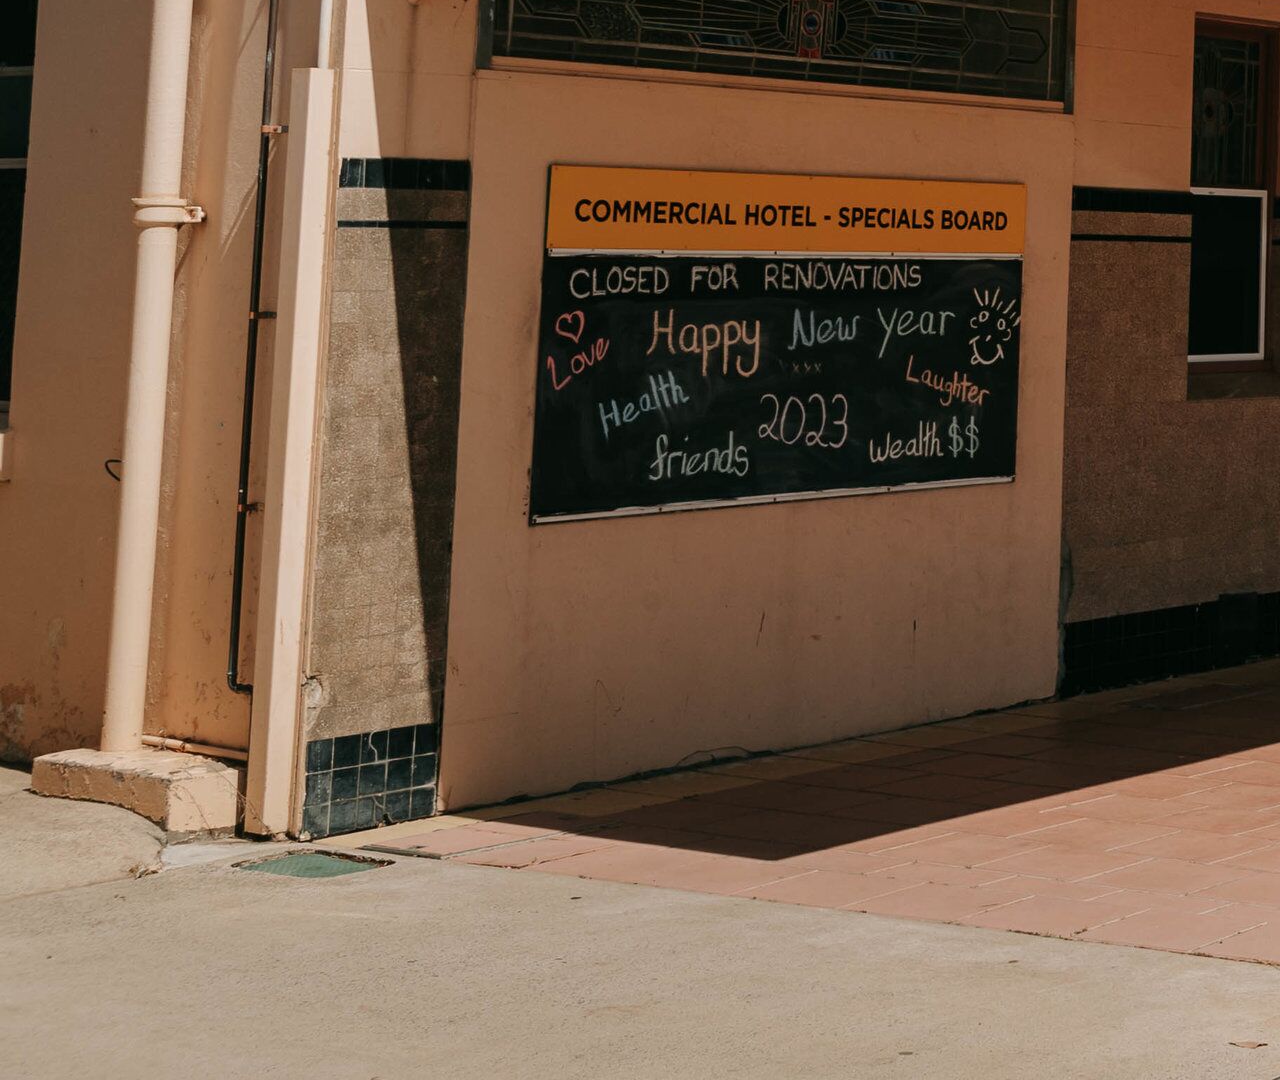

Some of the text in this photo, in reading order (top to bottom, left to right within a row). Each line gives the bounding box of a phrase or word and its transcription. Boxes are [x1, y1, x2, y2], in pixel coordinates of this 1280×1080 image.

[574, 198, 737, 226] COMMERCIAL
[744, 204, 817, 228] HOTEL
[838, 206, 935, 230] SPECIALS
[940, 209, 1009, 231] BOARD
[569, 262, 922, 299] CLOSED FOR RENOVATIONS
[546, 337, 610, 390] Love
[646, 309, 761, 378] Happy
[787, 308, 860, 350] New
[598, 370, 690, 440] Health
[905, 355, 991, 407] Laughter
[757, 392, 850, 449] 2023
[648, 430, 750, 481] friends
